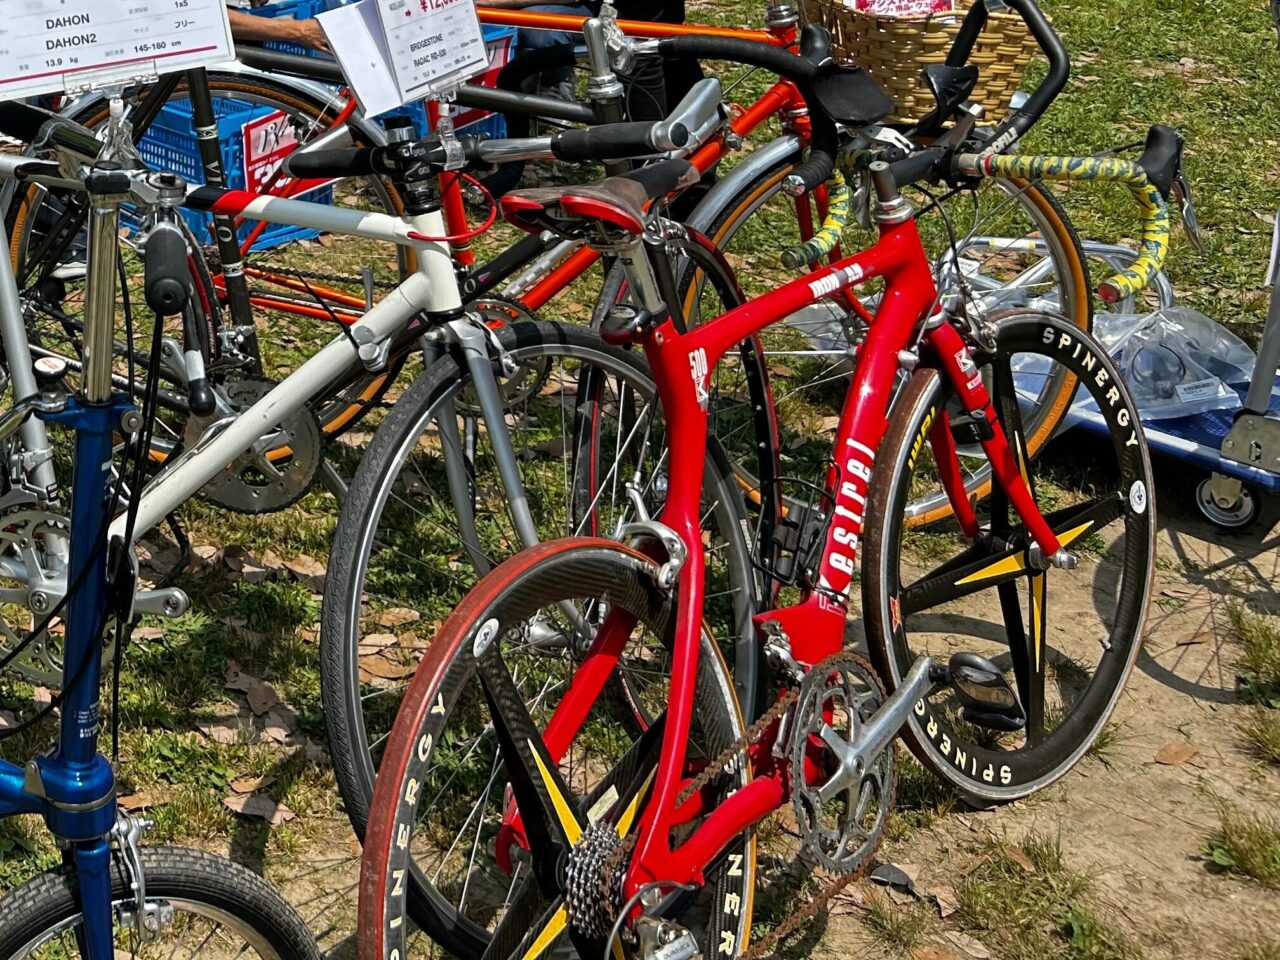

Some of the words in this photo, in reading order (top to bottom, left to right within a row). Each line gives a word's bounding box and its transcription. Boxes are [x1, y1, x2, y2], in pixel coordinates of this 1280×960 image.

[45, 13, 90, 30] DAHON
[174, 20, 195, 29] フリー
[45, 33, 97, 50] DAHON2
[134, 41, 167, 53] 145-180
[45, 57, 63, 68] 13.9
[688, 347, 708, 380] 500
[1042, 326, 1139, 448] SPINERGY
[914, 697, 1012, 785] SPINERG
